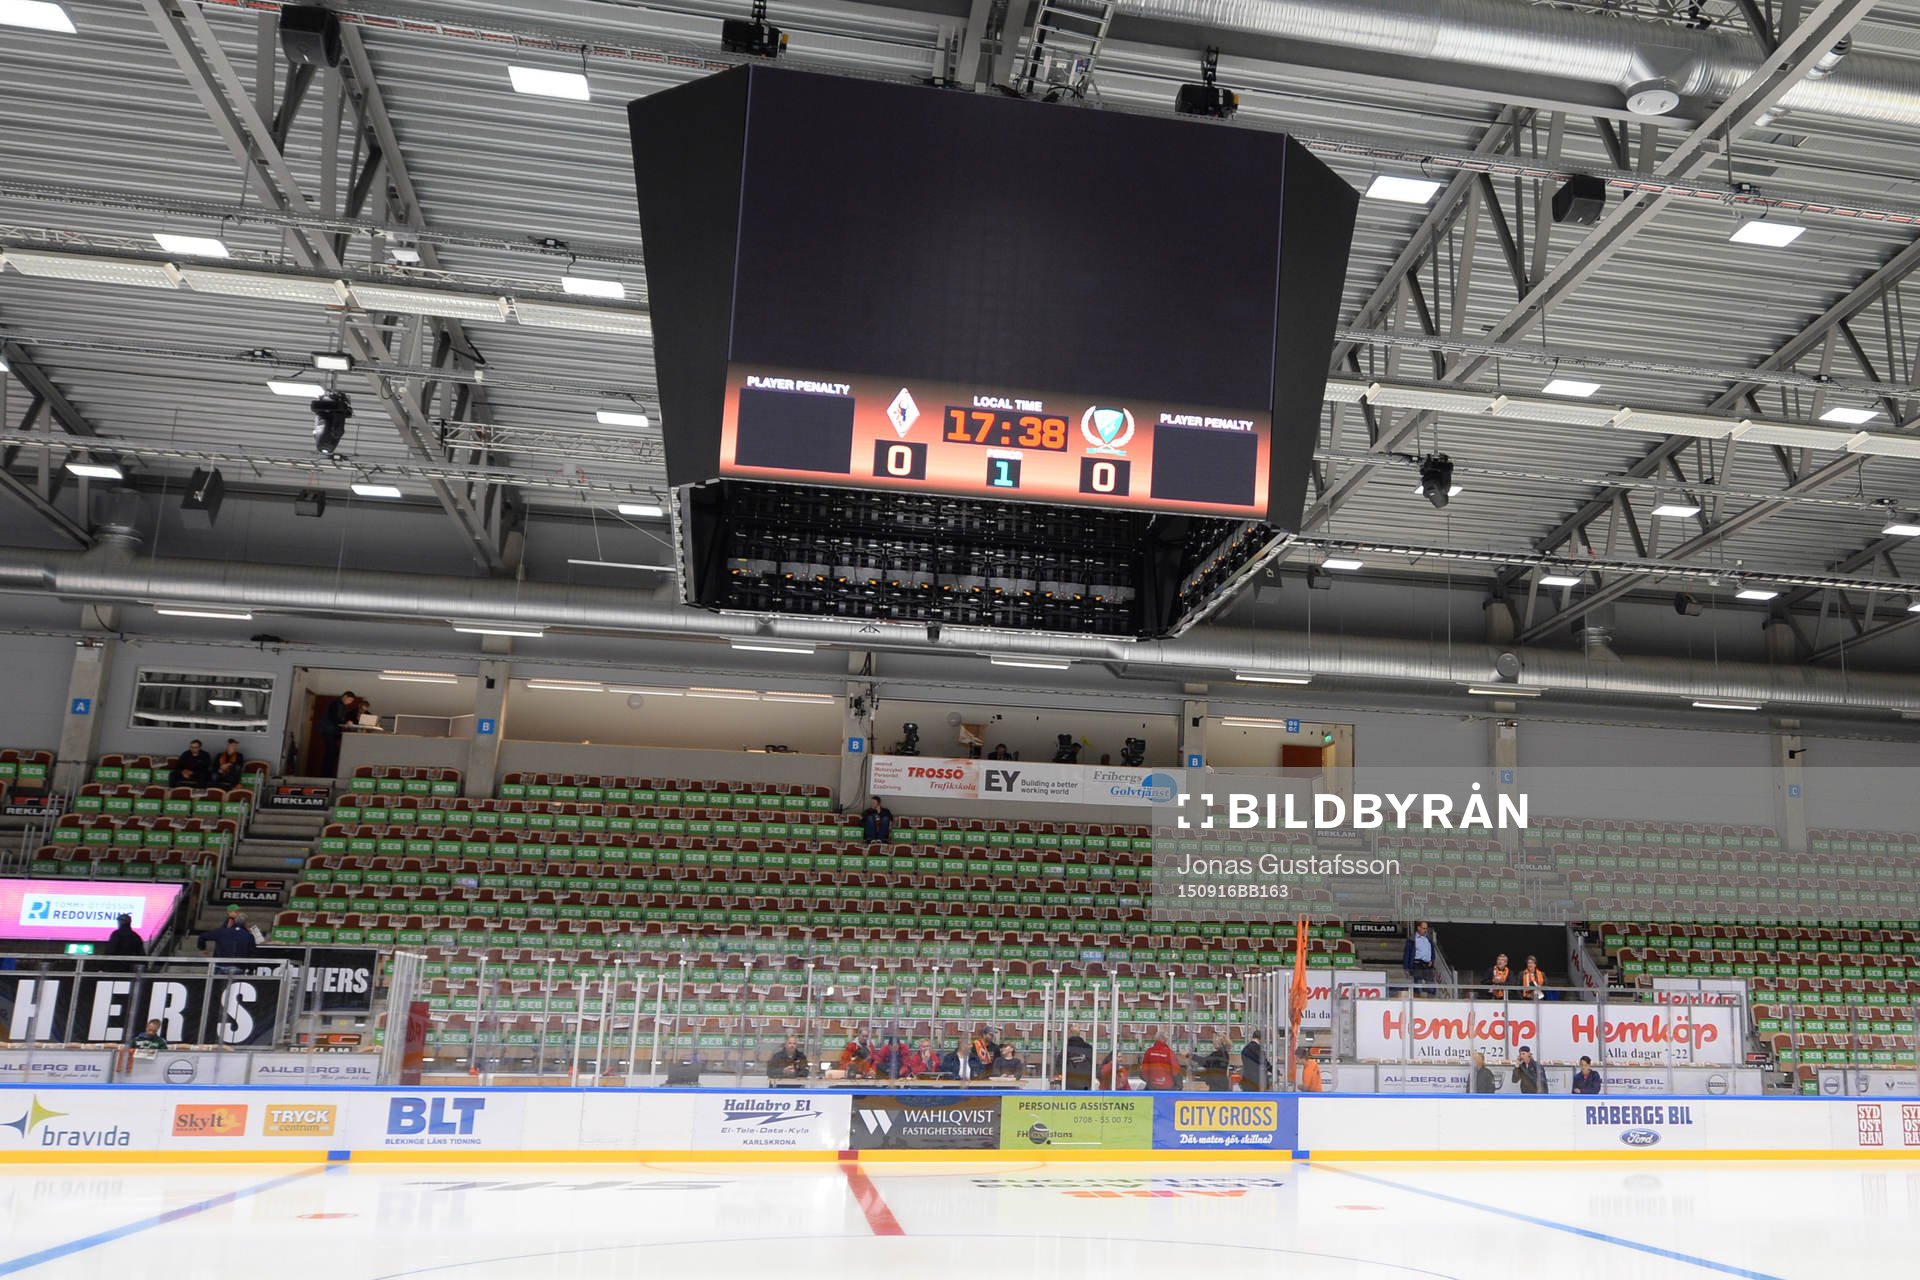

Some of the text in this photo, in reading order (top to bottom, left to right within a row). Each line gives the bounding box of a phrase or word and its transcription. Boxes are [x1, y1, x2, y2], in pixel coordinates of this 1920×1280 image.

[746, 375, 851, 396] PLAYER PENALTY
[973, 395, 1043, 413] LOCAL TIME
[1159, 412, 1254, 432] PLAYER PENALTY
[946, 409, 1067, 450] 17:38
[887, 444, 913, 477] 0
[993, 460, 1013, 487] 1
[1091, 461, 1117, 493] 0
[22, 767, 42, 775] SEB
[99, 770, 118, 778] SEB
[907, 765, 965, 780] TROSSÖ
[984, 769, 1021, 793] EY
[1093, 770, 1143, 784] Fribergs
[381, 782, 400, 790] SEB
[929, 780, 977, 793] Trafikskola
[1021, 779, 1050, 789] Building
[1057, 781, 1078, 789] better
[1021, 788, 1070, 796] working world
[1110, 785, 1171, 800] Golvtjänst
[272, 796, 324, 807] REKLAM
[811, 799, 829, 807] SEB
[5, 806, 61, 817] REKLAM
[87, 832, 108, 840] SEB
[178, 835, 199, 843] SEB
[967, 834, 985, 842] SEB
[1317, 829, 1357, 840] REKLAM
[222, 890, 278, 902] REKLAM
[53, 910, 133, 921] REDOVISNI
[275, 930, 298, 938] SEB
[1352, 923, 1396, 934] REKLAM
[338, 932, 361, 940] SEB
[369, 933, 392, 941] SEB
[1186, 953, 1204, 961] SEB
[1236, 954, 1255, 962] SEB
[1335, 956, 1354, 964] SEB
[513, 967, 535, 976] SEB
[1647, 964, 1665, 972] SEB
[1757, 993, 1776, 1001] SEB
[998, 1009, 1018, 1017] SEB
[1382, 1009, 1537, 1047] Hemköp
[1571, 1013, 1719, 1050] Hemköp
[1828, 1022, 1846, 1030] SEB
[1873, 1023, 1891, 1031] SEB
[1417, 1046, 1442, 1057] Alla
[1605, 1048, 1628, 1059] Alla
[1630, 1049, 1662, 1060] dagar
[1827, 1052, 1846, 1060] SEB
[74, 1064, 103, 1072] BIL
[345, 1066, 372, 1074] BIL
[723, 1099, 811, 1112] Hallabro El
[1018, 1102, 1135, 1112] PERSONLIG ASSISTANS
[270, 1110, 330, 1123] TRYCK
[386, 1097, 486, 1135] BLT
[904, 1109, 995, 1124] WAHLQVIST
[1179, 1106, 1273, 1126] CITY GROSS
[1586, 1101, 1693, 1125] RÅBERGS BIL
[1858, 1105, 1880, 1119] SYD
[175, 1112, 224, 1132] Skylt
[1073, 1116, 1092, 1124] 0708
[1111, 1116, 1123, 1124] 00
[1859, 1119, 1881, 1132] OST
[278, 1122, 320, 1133] centrum
[902, 1126, 994, 1136] FASTIGHETSSERVICE
[41, 1124, 131, 1147] bravida
[426, 1136, 448, 1145] LÄNS
[1179, 1133, 1273, 1146] Där maten gör skillnad
[1626, 1132, 1655, 1145] Ford
[1860, 1131, 1883, 1145] RAN
[1904, 1131, 1920, 1145] RA
[742, 1138, 797, 1146] KARLSKRONA
